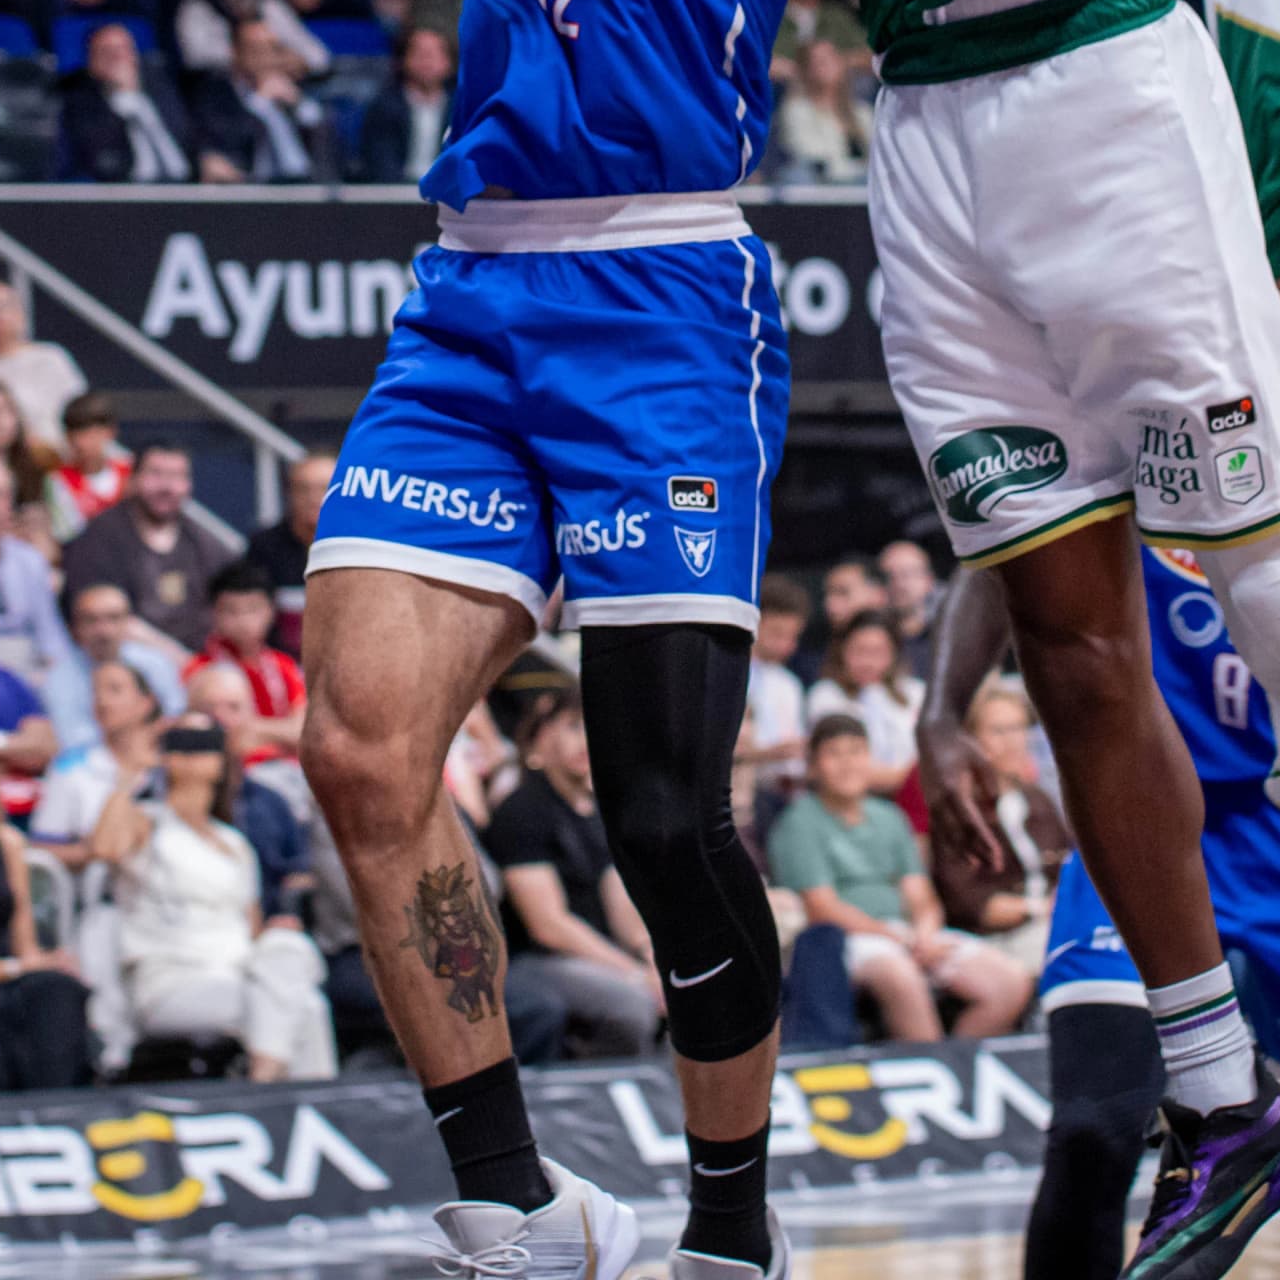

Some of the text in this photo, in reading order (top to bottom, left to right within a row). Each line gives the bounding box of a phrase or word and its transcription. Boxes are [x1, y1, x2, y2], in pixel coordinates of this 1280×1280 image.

[1210, 411, 1248, 431] acb
[1142, 417, 1200, 461] má
[341, 465, 517, 533] INVERSUS
[674, 489, 709, 507] acb
